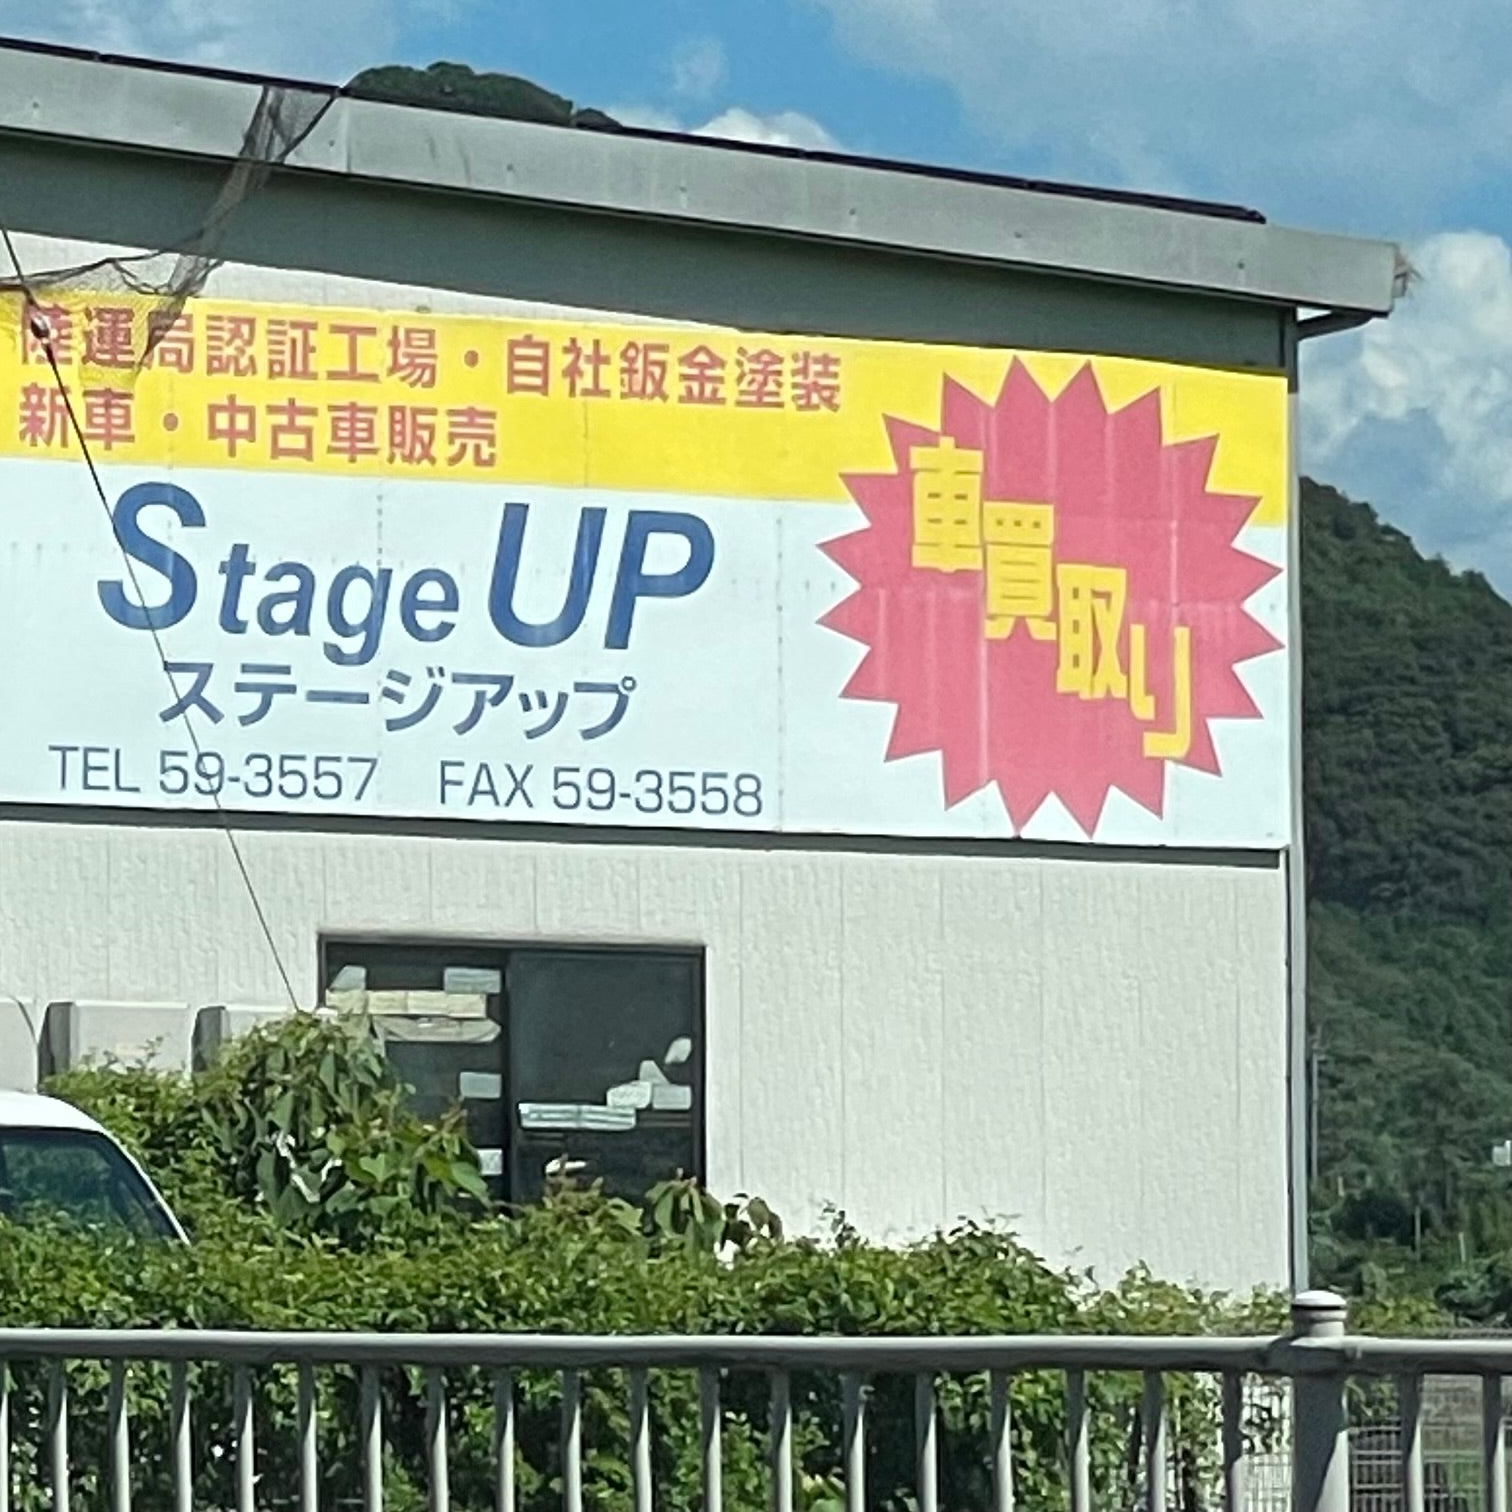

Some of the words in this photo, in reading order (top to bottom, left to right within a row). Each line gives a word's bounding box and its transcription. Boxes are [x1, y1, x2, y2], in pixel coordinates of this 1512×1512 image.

[19, 382, 498, 468] 新車・中古車販売
[97, 481, 460, 665] Stage
[488, 502, 715, 651] UP
[909, 435, 1192, 758] 車買取り
[159, 660, 637, 742] ステージアップ
[49, 744, 140, 794] TEL
[159, 750, 379, 803] 59-3557
[439, 762, 535, 810] FAX
[552, 767, 764, 817] 59-3558
